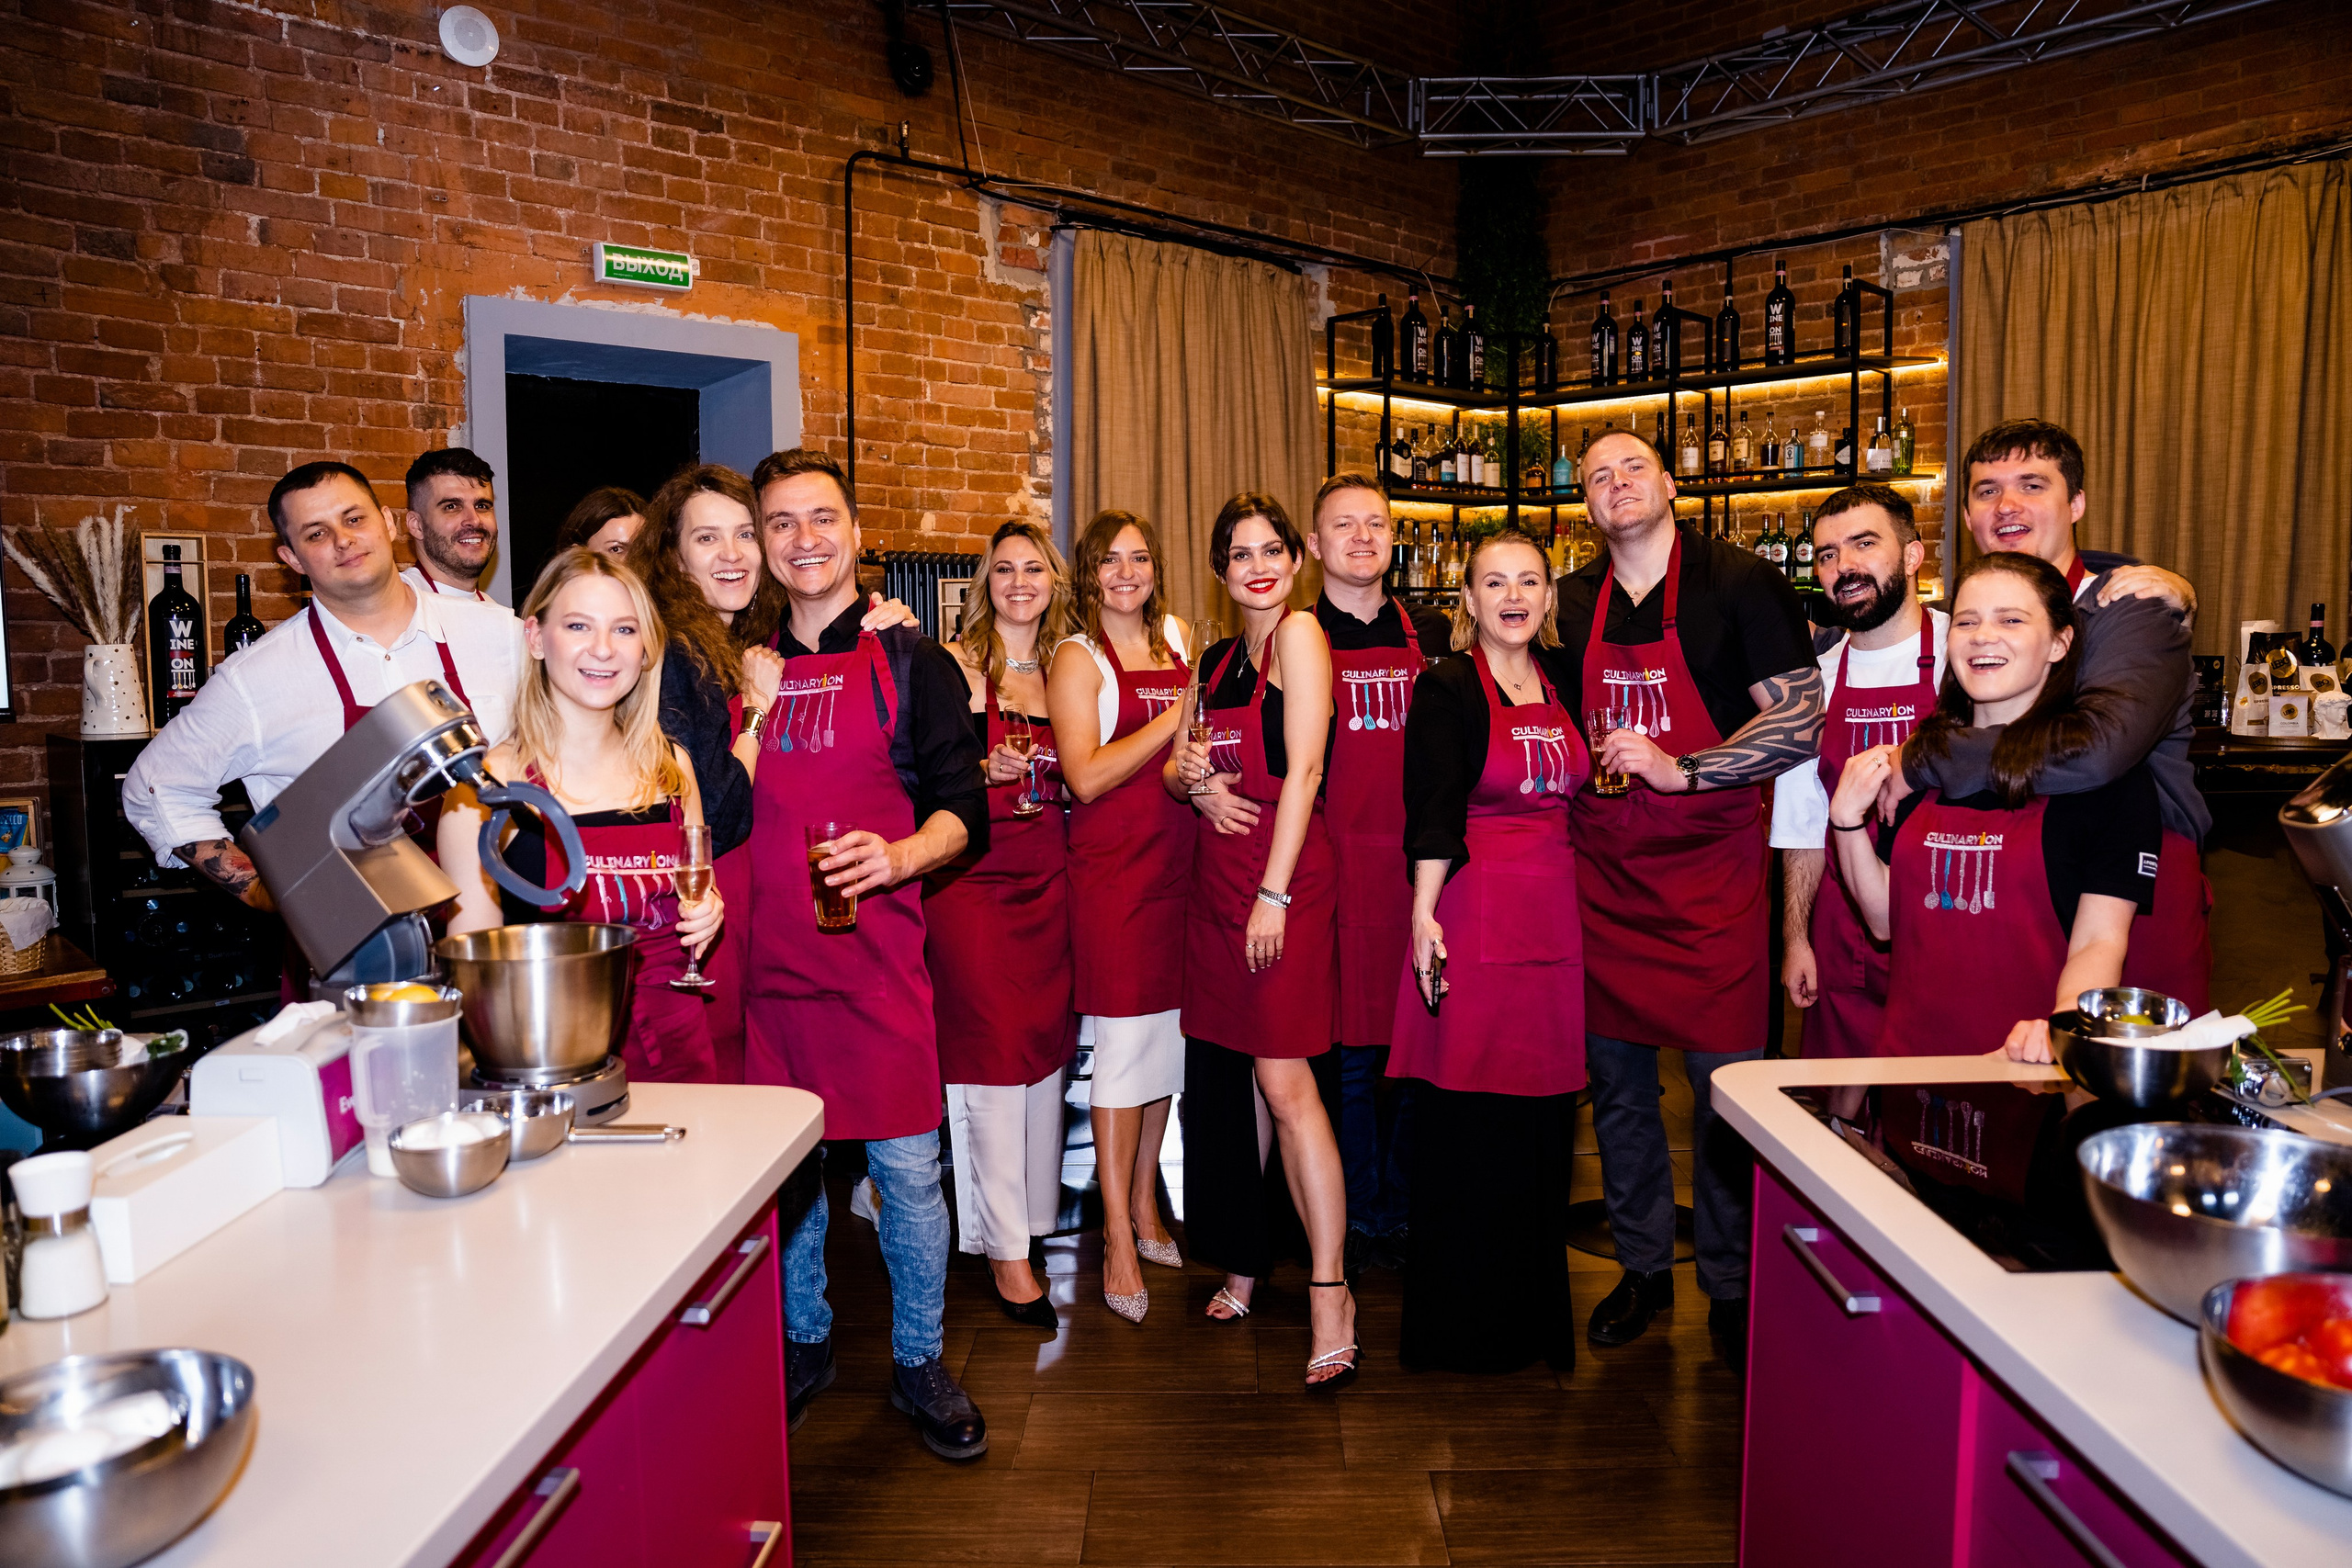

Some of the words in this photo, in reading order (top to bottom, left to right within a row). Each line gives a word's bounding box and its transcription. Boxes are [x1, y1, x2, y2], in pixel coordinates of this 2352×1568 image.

[612, 253, 684, 281] ВЫХОД
[169, 620, 193, 637] W
[170, 639, 195, 650] INE
[171, 658, 194, 670] ON
[2270, 657, 2290, 671] LEBO
[2282, 707, 2295, 716] LEBO
